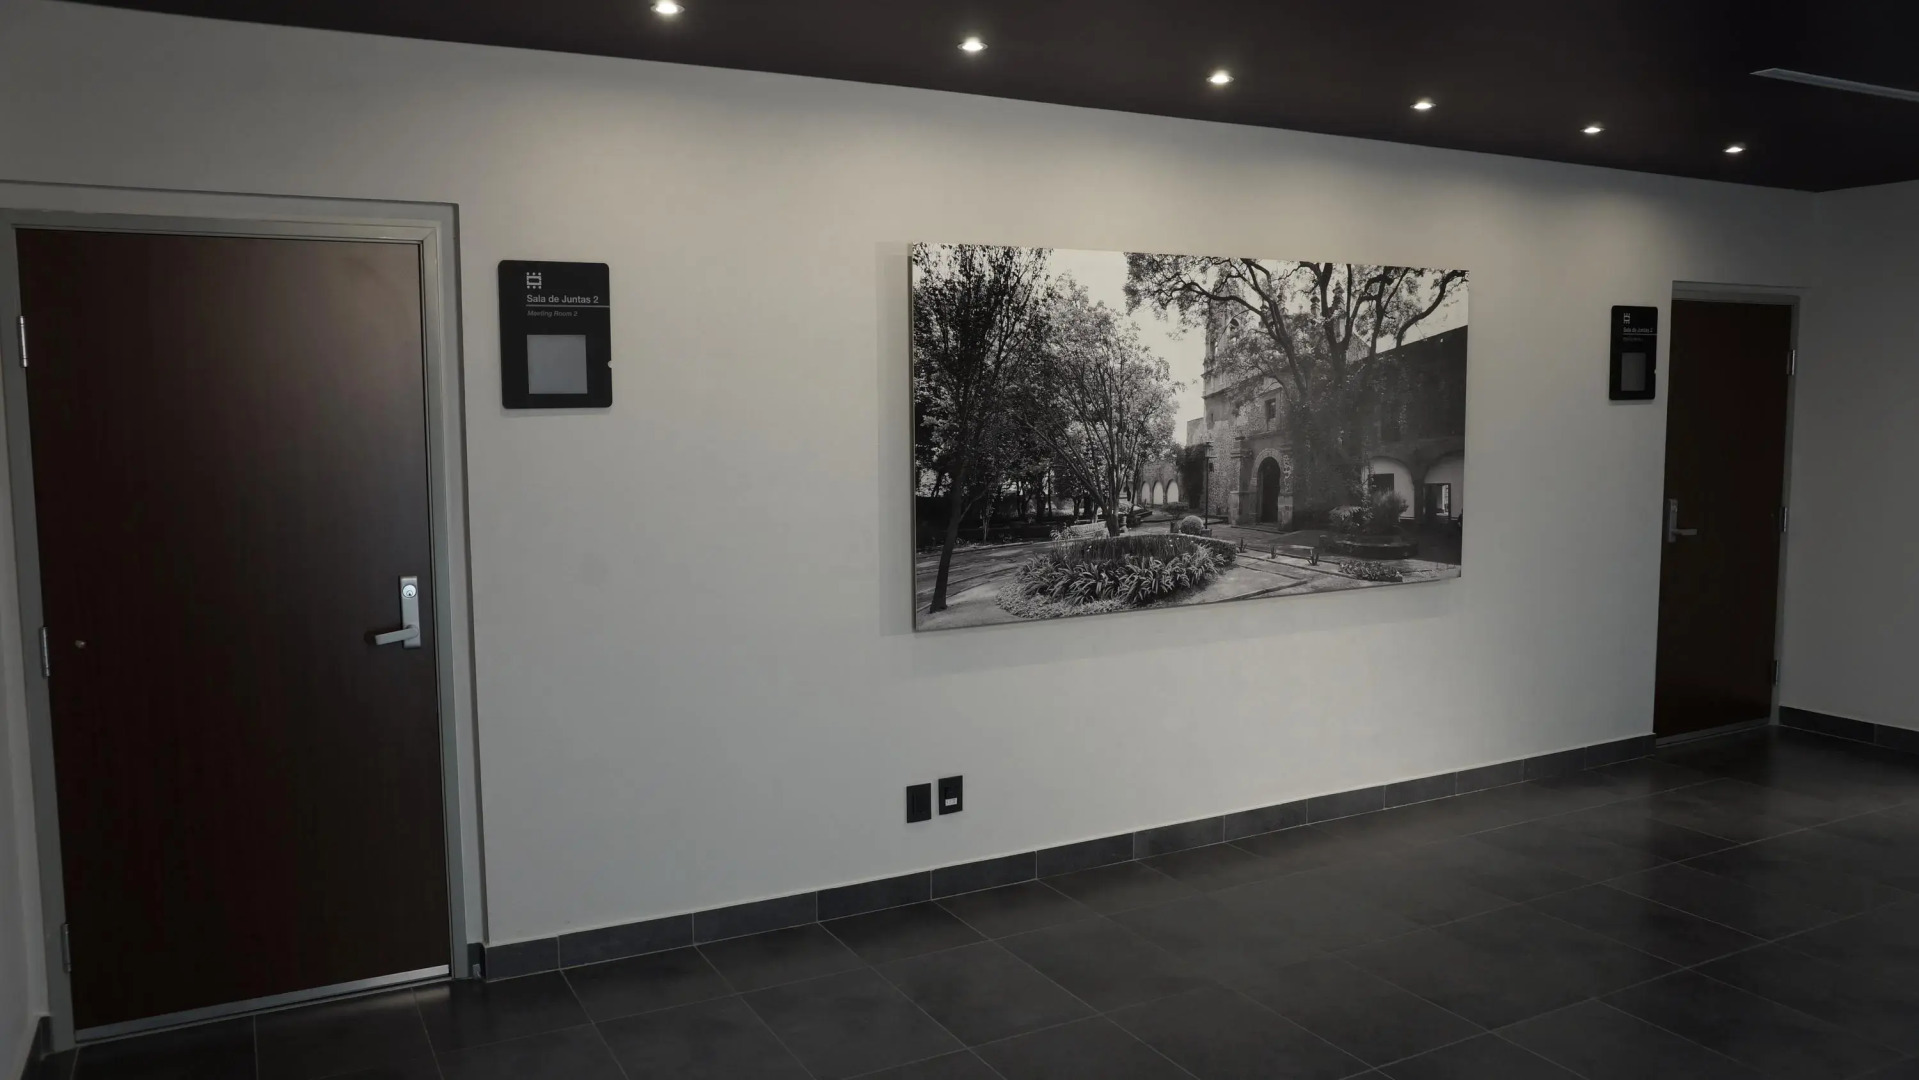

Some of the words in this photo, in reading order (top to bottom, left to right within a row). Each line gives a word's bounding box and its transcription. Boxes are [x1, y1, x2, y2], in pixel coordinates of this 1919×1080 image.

[526, 294, 546, 303] Sala
[548, 295, 560, 303] de
[561, 295, 591, 304] Juntas
[593, 295, 599, 304] 2
[527, 310, 552, 318] Meeting
